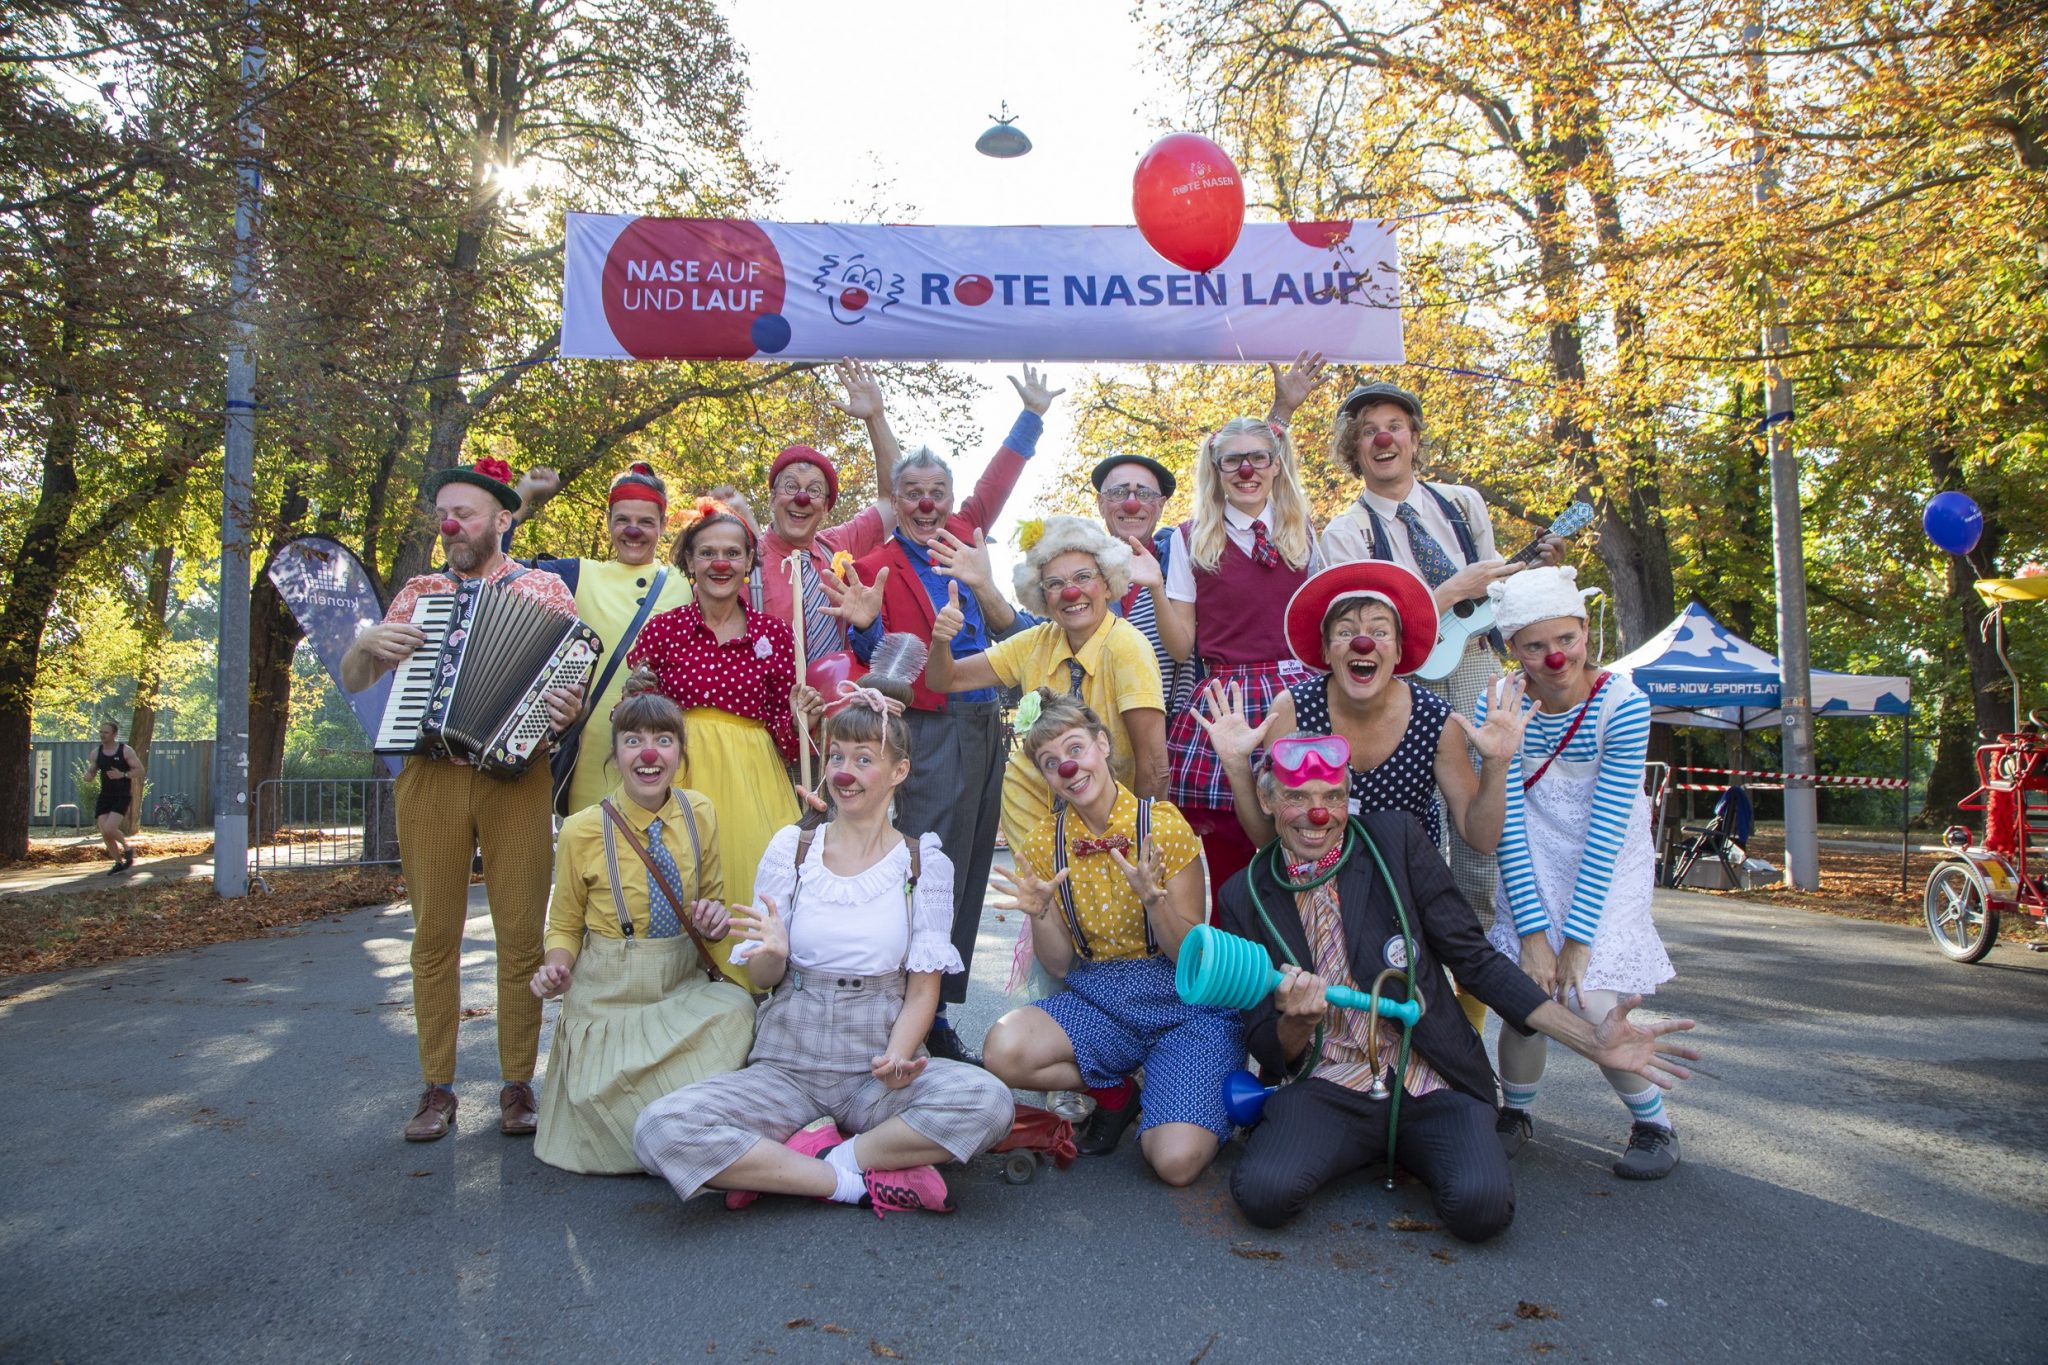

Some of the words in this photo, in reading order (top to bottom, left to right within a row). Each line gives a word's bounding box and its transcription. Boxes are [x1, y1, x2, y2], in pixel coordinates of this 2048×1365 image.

[1172, 181, 1201, 197] ROTE
[1202, 176, 1234, 189] NASEN
[627, 259, 700, 282] NASE
[706, 261, 761, 283] AUF
[623, 288, 684, 311] UND
[691, 288, 764, 312] LAUF
[921, 273, 1050, 306] ROTE
[1063, 273, 1228, 306] NASEN
[1242, 272, 1361, 305] LAUF
[1647, 682, 1779, 695] TIME-NOW-SPORTS.AT
